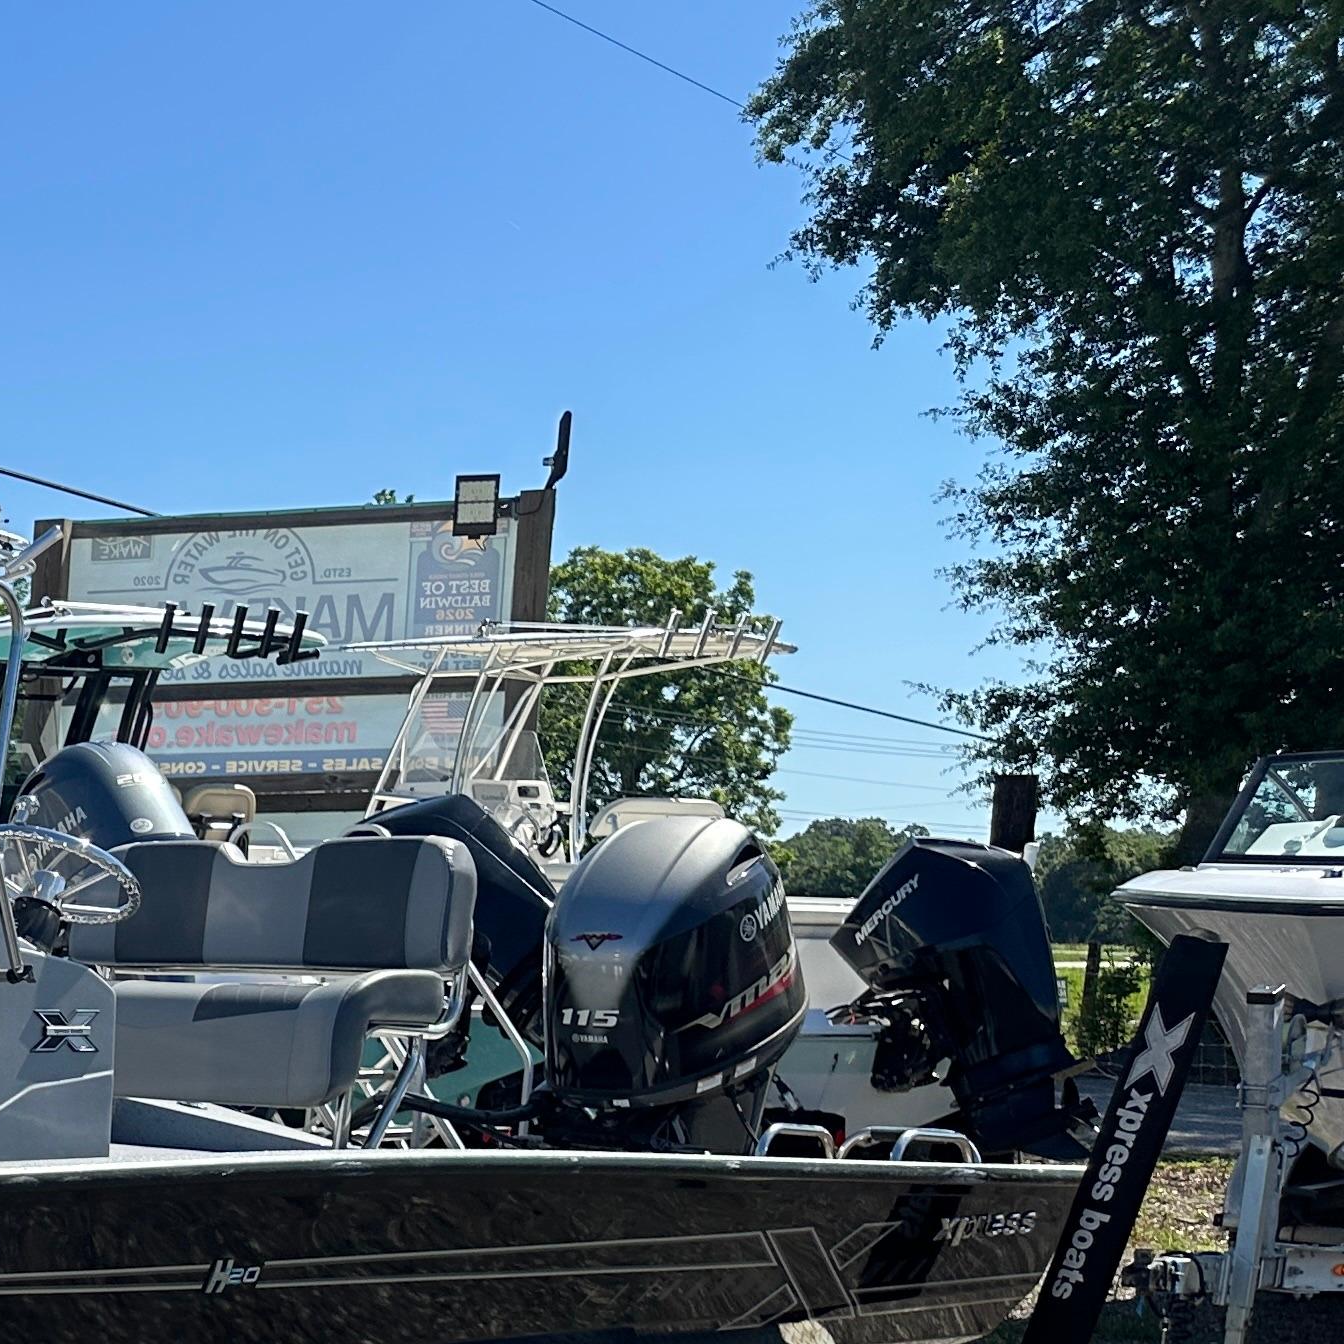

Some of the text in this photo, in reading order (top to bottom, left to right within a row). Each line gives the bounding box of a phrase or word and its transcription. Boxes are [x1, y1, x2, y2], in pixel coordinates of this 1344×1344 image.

[854, 873, 920, 946] MERCURY
[561, 1007, 620, 1028] 115
[578, 1034, 609, 1044] YAMAHA
[1051, 1087, 1154, 1300] xpress boats
